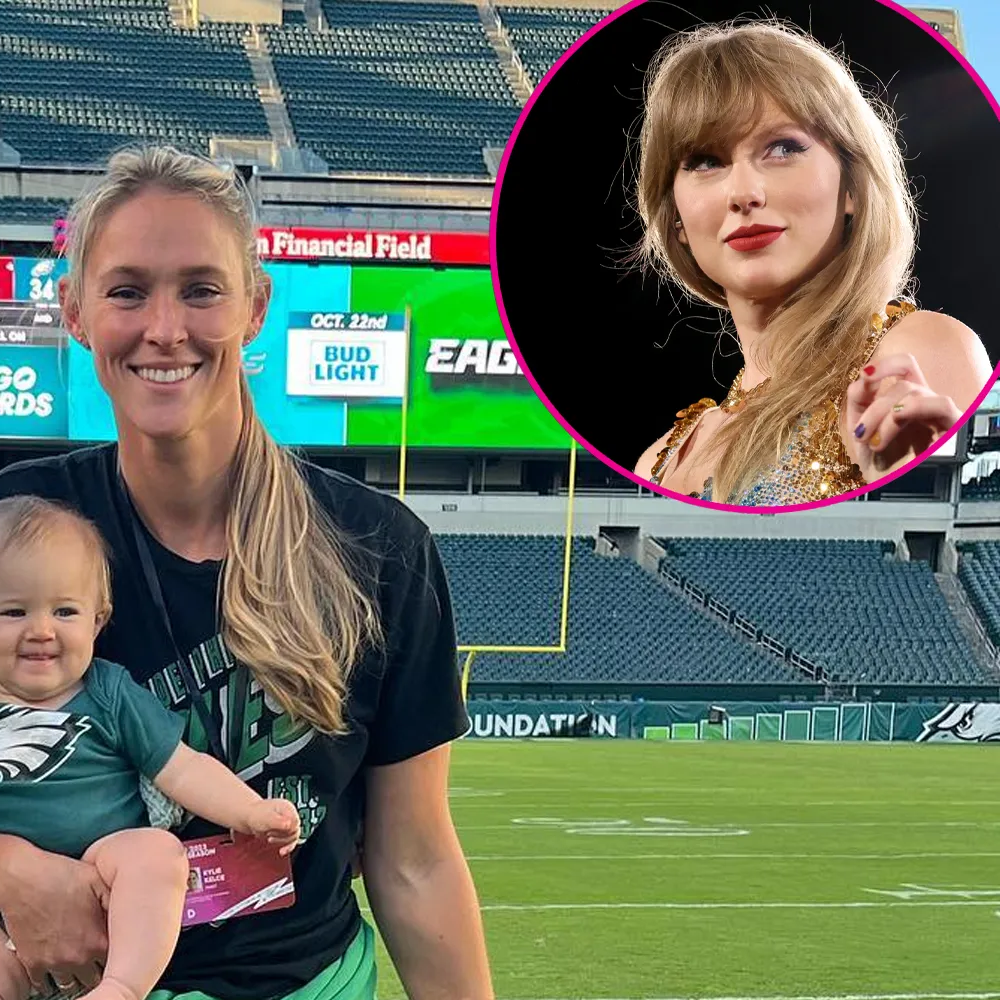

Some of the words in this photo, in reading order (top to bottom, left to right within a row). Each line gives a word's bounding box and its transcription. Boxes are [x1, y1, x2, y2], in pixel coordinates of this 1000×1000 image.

[272, 231, 373, 258] Financial
[375, 235, 431, 260] Field
[29, 278, 55, 300] 34
[310, 313, 345, 329] OCT.
[348, 314, 388, 330] 22nd
[324, 345, 371, 362] BUD
[424, 338, 523, 375] EAG
[315, 362, 380, 381] LIGHT
[468, 713, 617, 737] UNDATIN
[187, 908, 196, 919] D
